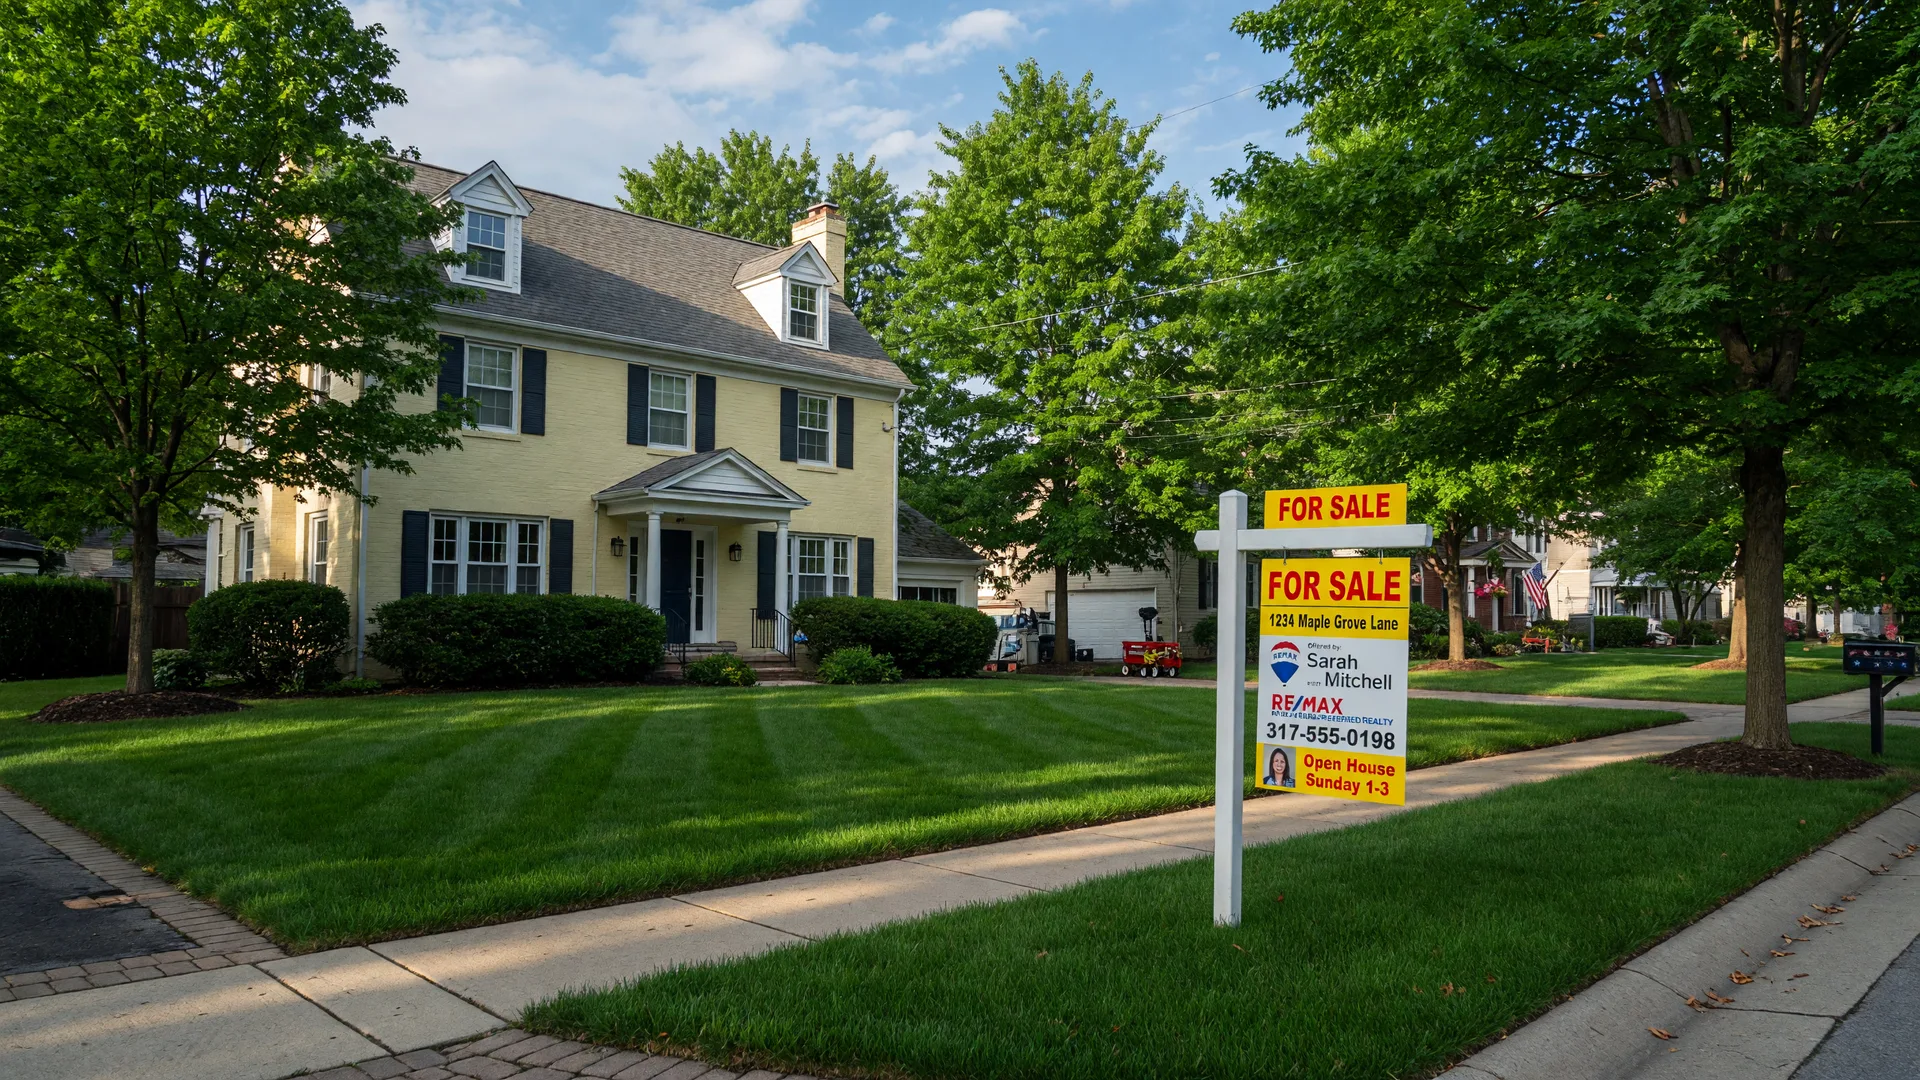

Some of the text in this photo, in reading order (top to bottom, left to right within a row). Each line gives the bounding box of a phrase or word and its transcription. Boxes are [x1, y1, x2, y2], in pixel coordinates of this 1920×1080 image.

[1279, 493, 1390, 521] FOR SALE
[1268, 570, 1401, 601] FOR SALE
[1269, 613, 1398, 631] 1234 Maple Grove Lane
[1307, 652, 1358, 670] Sarah
[1325, 672, 1392, 690] Mitchell
[1272, 693, 1343, 715] RE/MAX
[1362, 716, 1393, 726] REALTY
[1266, 722, 1395, 750] 317-555-0198
[1303, 754, 1395, 777] Open House
[1306, 773, 1389, 796] Sunday 1-3
